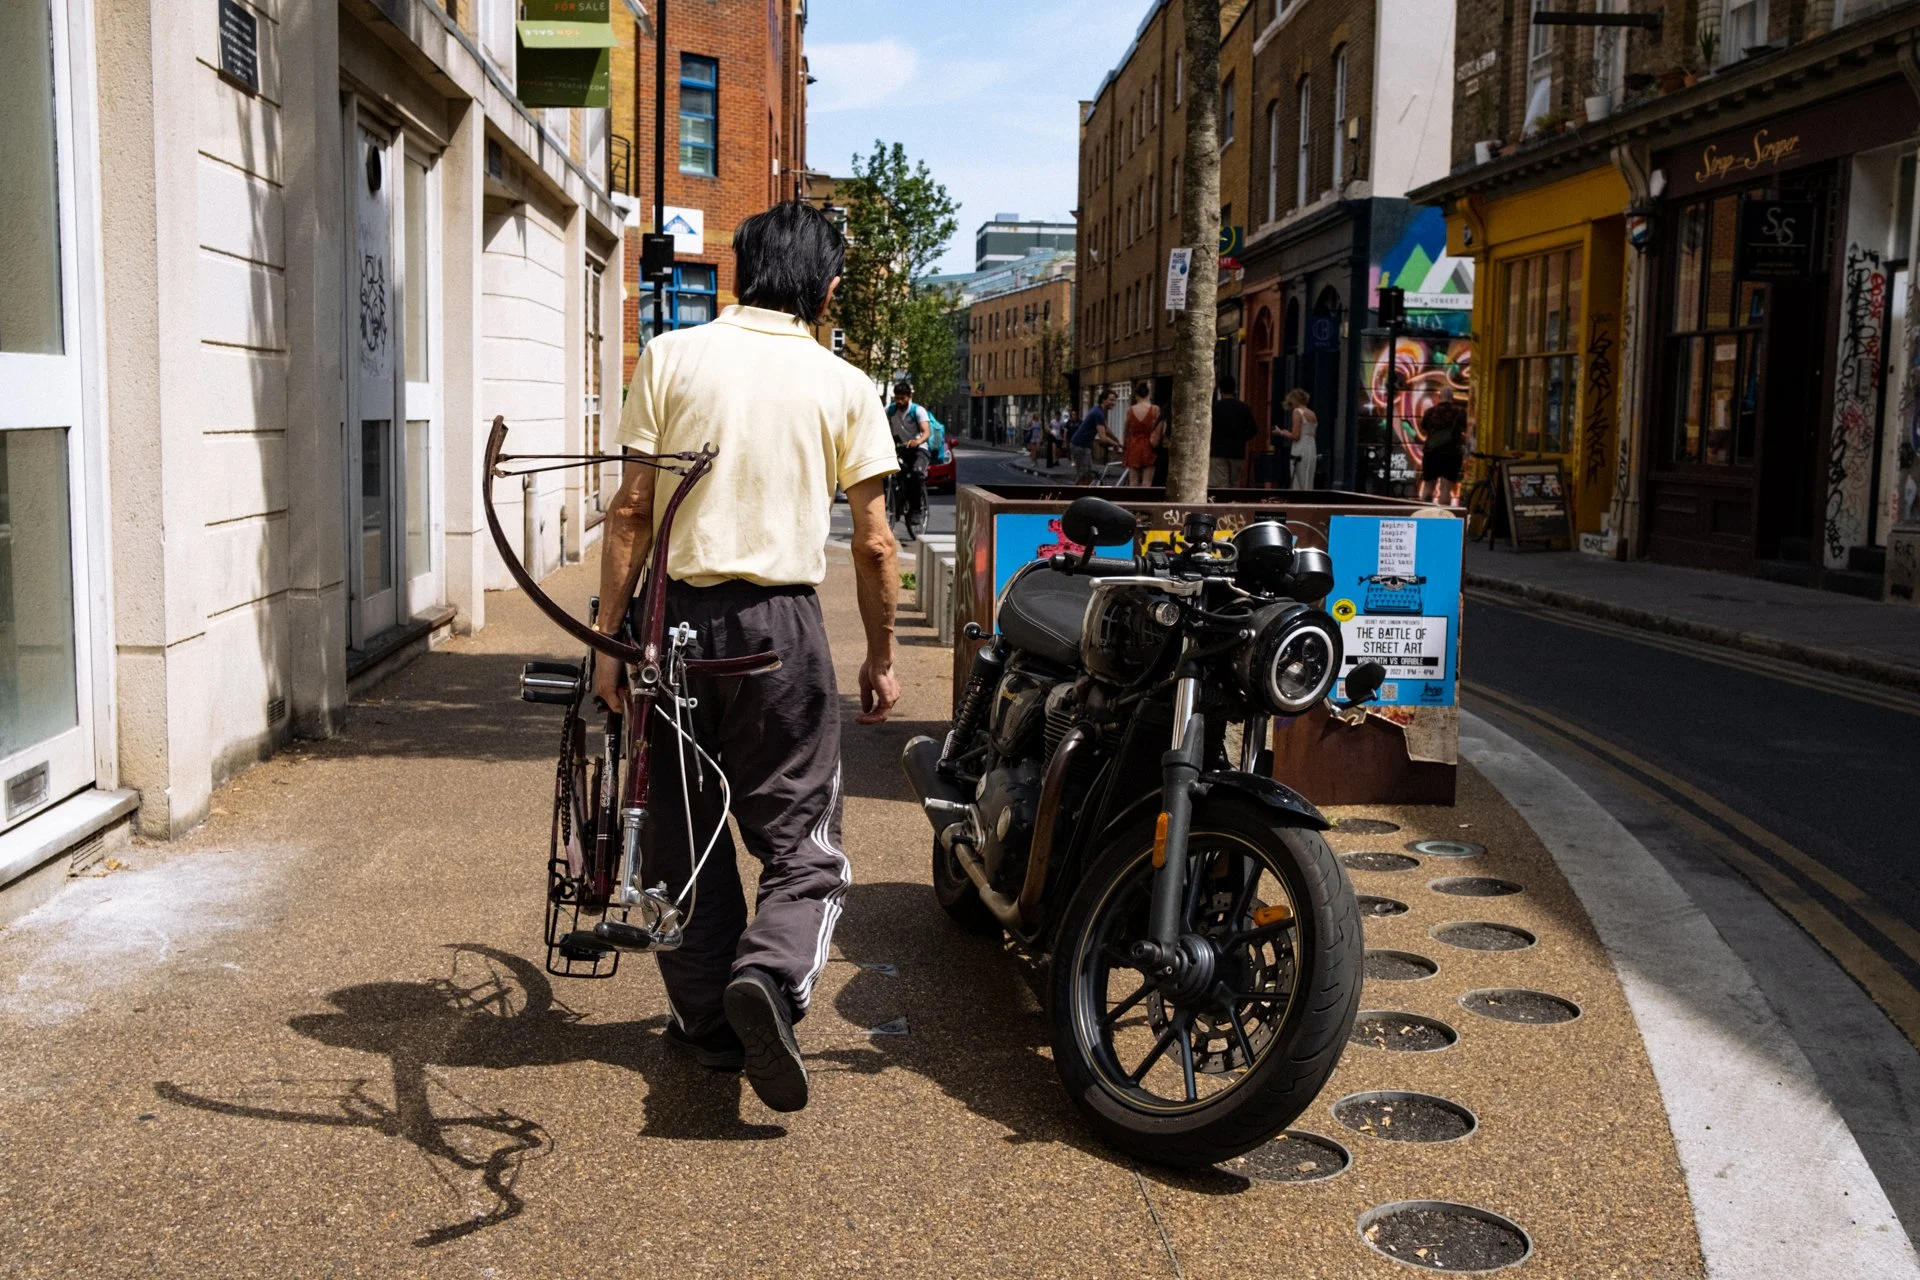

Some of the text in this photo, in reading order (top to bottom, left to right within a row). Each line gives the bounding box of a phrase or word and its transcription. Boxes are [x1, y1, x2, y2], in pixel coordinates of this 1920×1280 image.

[554, 2, 607, 11] FOR SALE
[1381, 522, 1404, 530] Aspire
[1356, 627, 1427, 640] THE BATTLE OF
[1363, 641, 1423, 654] STREET ART
